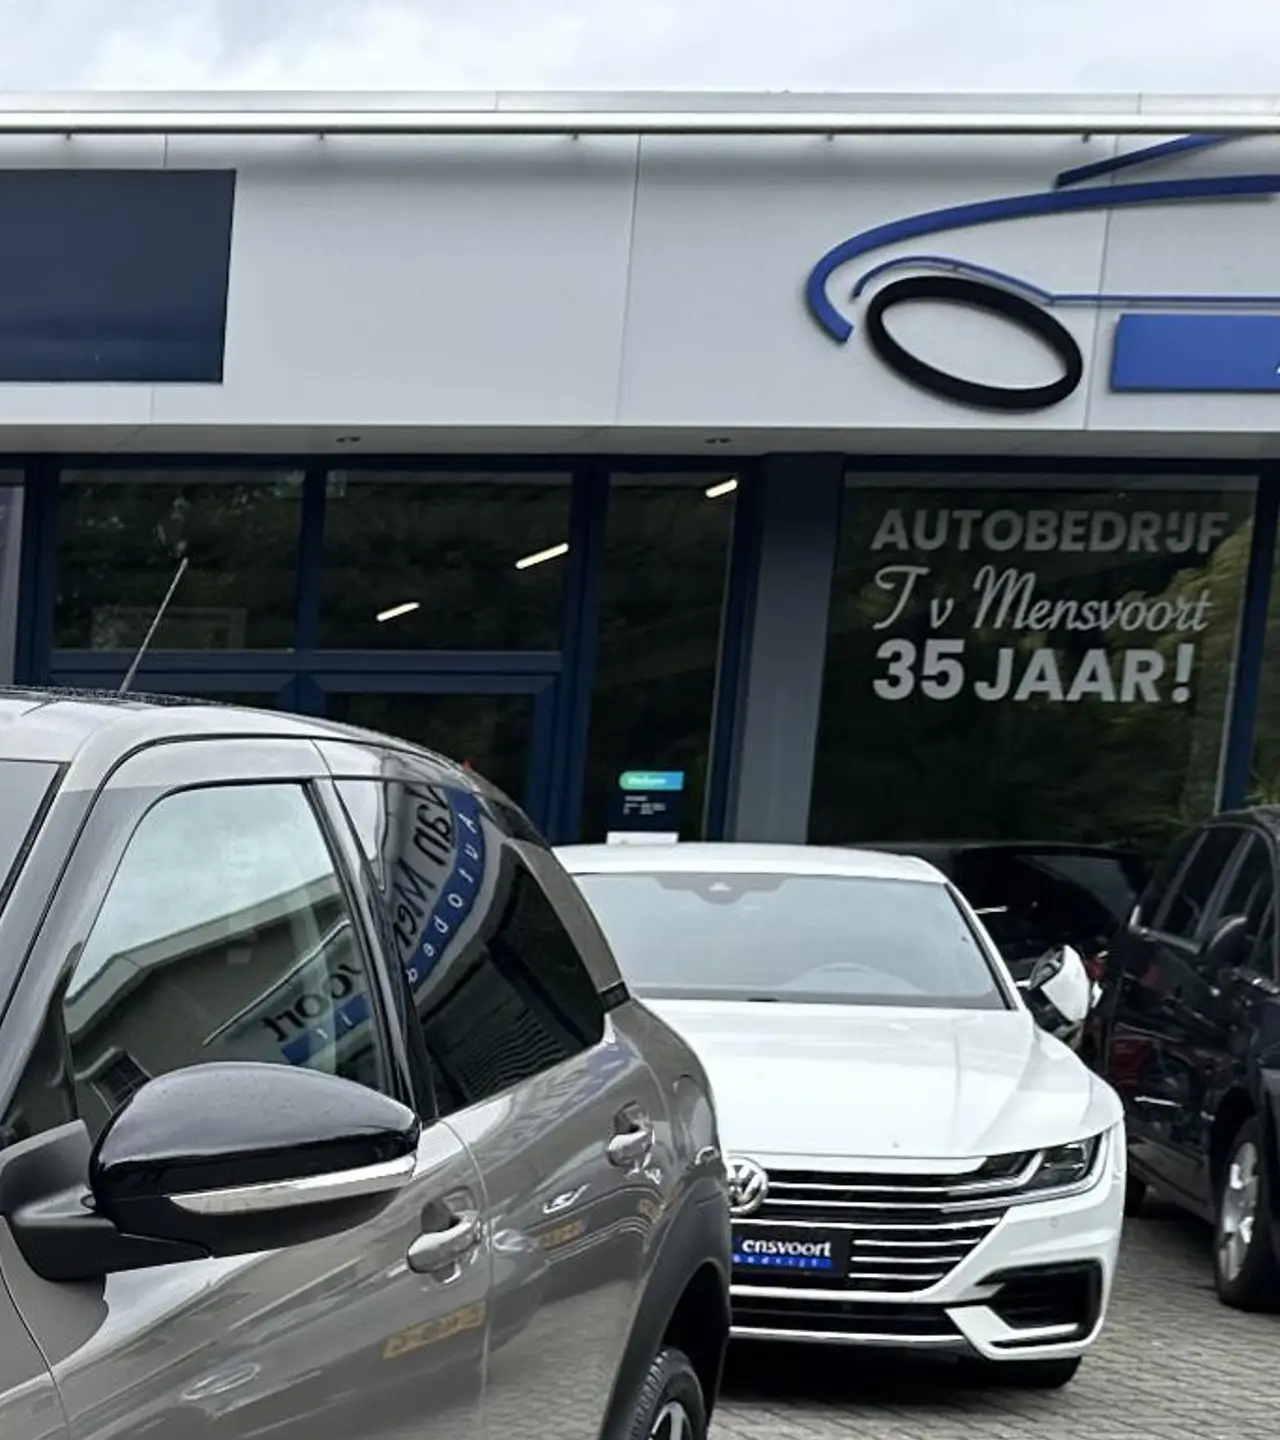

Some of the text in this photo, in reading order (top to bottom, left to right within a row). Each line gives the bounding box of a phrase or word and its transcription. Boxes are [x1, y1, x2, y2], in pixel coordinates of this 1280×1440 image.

[870, 508, 1230, 554] AUTOBEDRIJF
[972, 563, 1214, 632] Mensvoort
[872, 638, 1196, 704] 35 JAAR!
[736, 1238, 832, 1257] ensvoort
